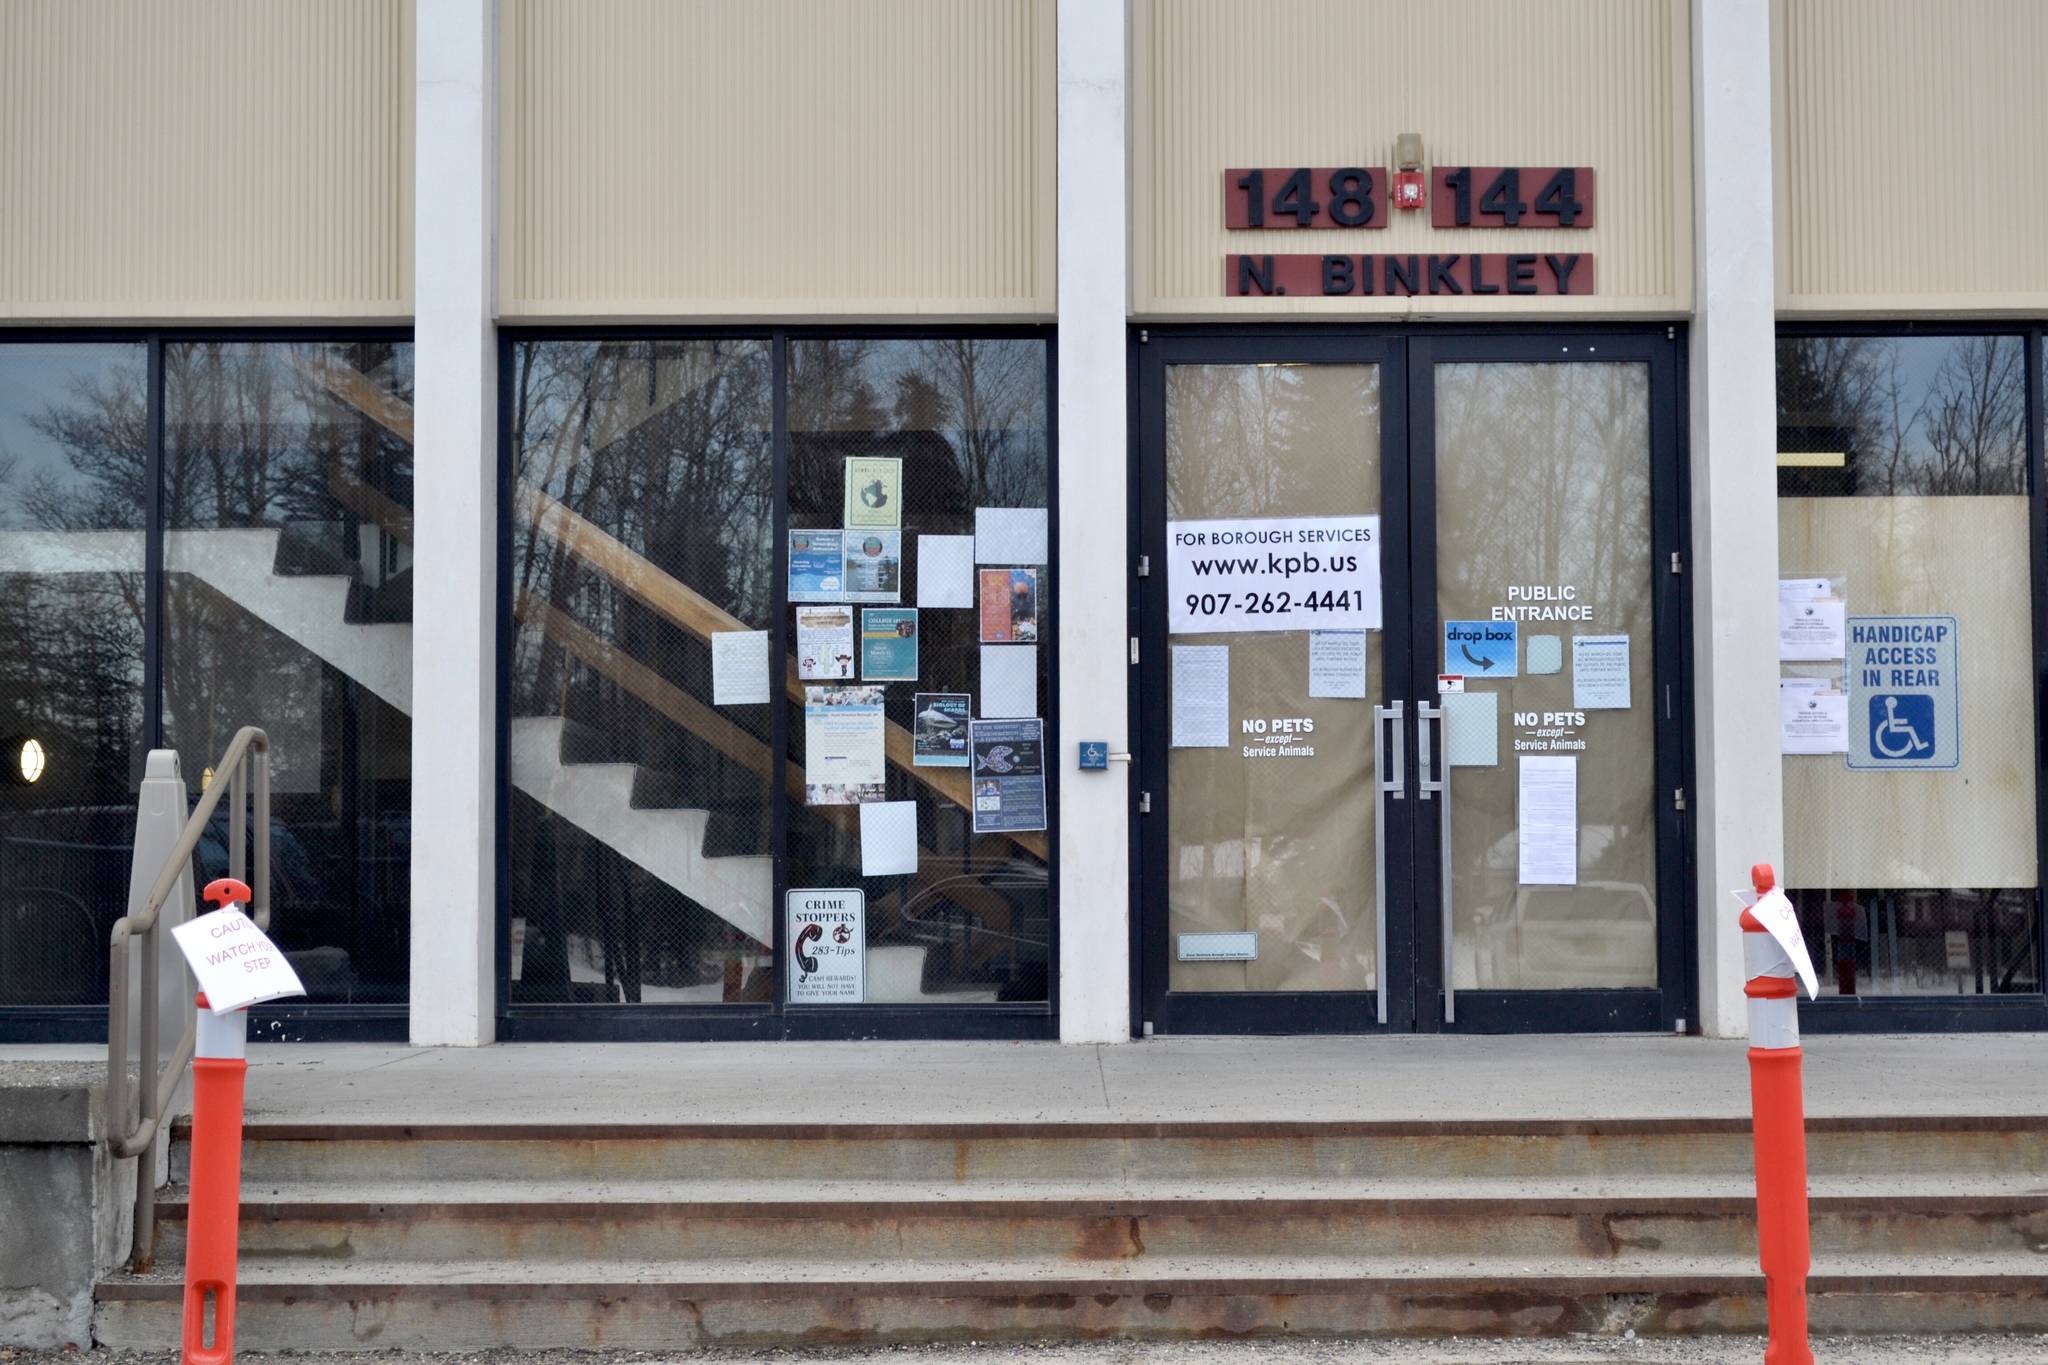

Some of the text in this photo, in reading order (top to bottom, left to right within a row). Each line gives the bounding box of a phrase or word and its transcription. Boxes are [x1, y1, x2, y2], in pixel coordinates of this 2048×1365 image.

[1239, 168, 1374, 226] 148
[1446, 167, 1582, 225] 144
[1239, 253, 1580, 295] N. BINKLEY
[1176, 529, 1370, 545] FOR BOROUGH SERVICES
[1192, 552, 1357, 577] www.kpb.us
[1508, 586, 1575, 601] PUBLIC
[1186, 590, 1362, 615] 907-262-4441
[1492, 605, 1593, 621] ENTRANCE
[1448, 627, 1513, 643] drop box
[1853, 626, 1947, 643] HANDICAP
[1865, 648, 1936, 664] ACCESS
[1863, 670, 1939, 686] IN REAR
[1243, 719, 1314, 733] NO PETS
[1515, 712, 1585, 726] NO PETS
[1265, 734, 1292, 744] except
[1537, 728, 1564, 738] except
[1243, 746, 1314, 757] Service Animals
[1515, 739, 1585, 750] Service Animals
[805, 900, 845, 909] CRIME
[796, 913, 855, 922] STOPPERS
[206, 943, 256, 965] WATCH
[812, 946, 855, 956] 283-Tips
[244, 957, 271, 973] STEP
